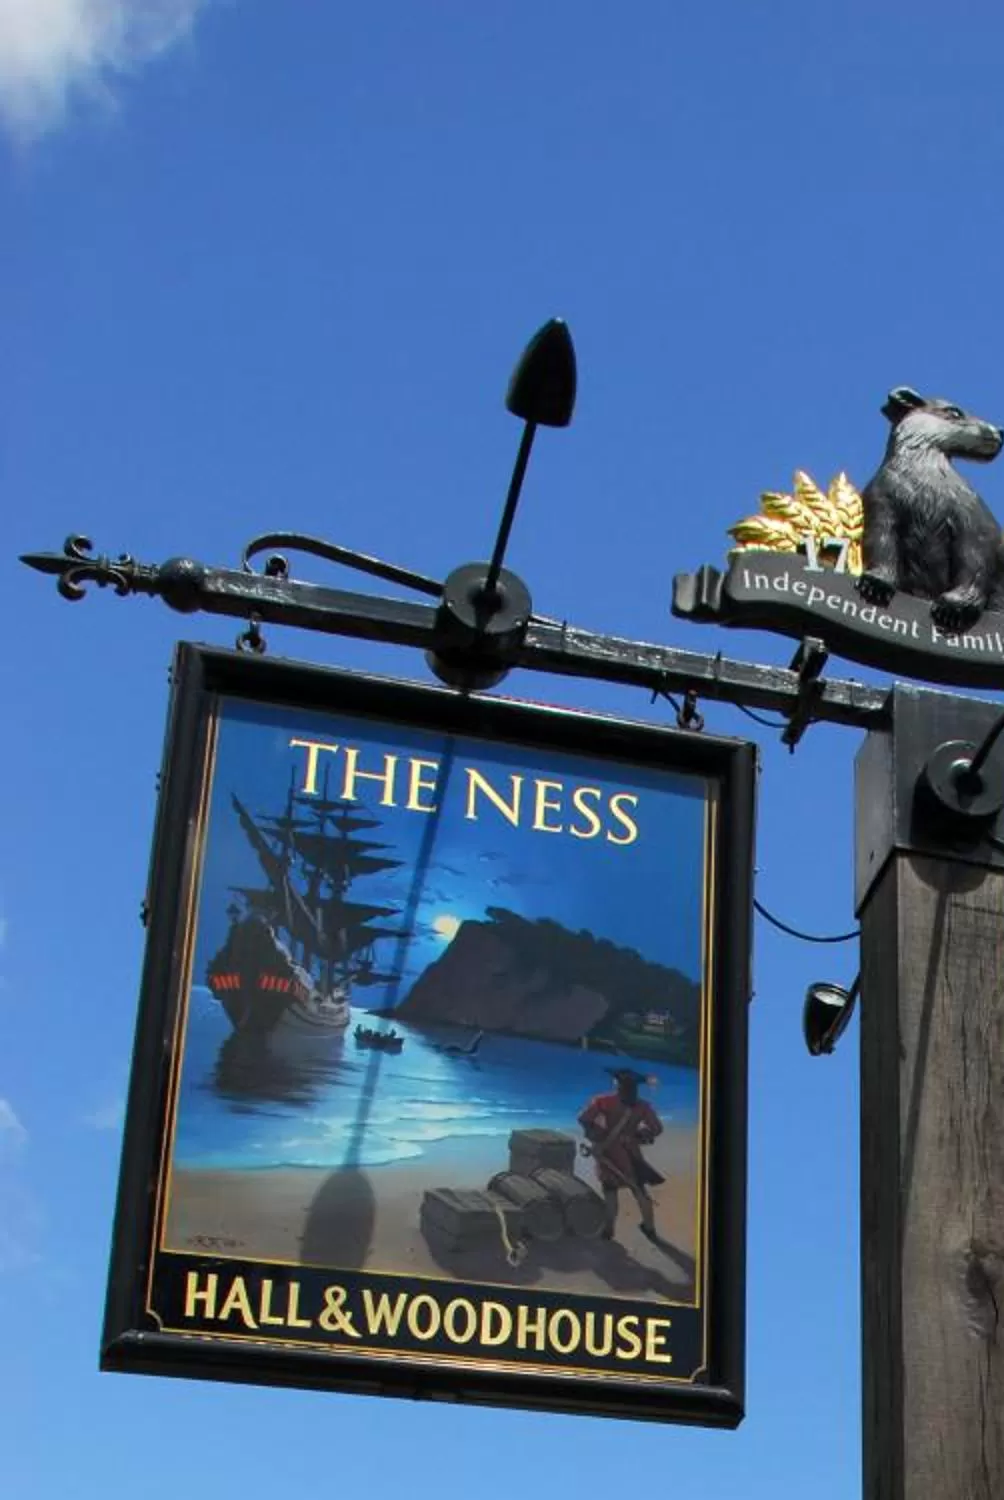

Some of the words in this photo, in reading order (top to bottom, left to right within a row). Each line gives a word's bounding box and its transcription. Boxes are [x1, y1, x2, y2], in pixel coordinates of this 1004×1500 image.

[743, 568, 919, 639] Independent
[289, 736, 439, 814] THE
[463, 766, 639, 846] NESS
